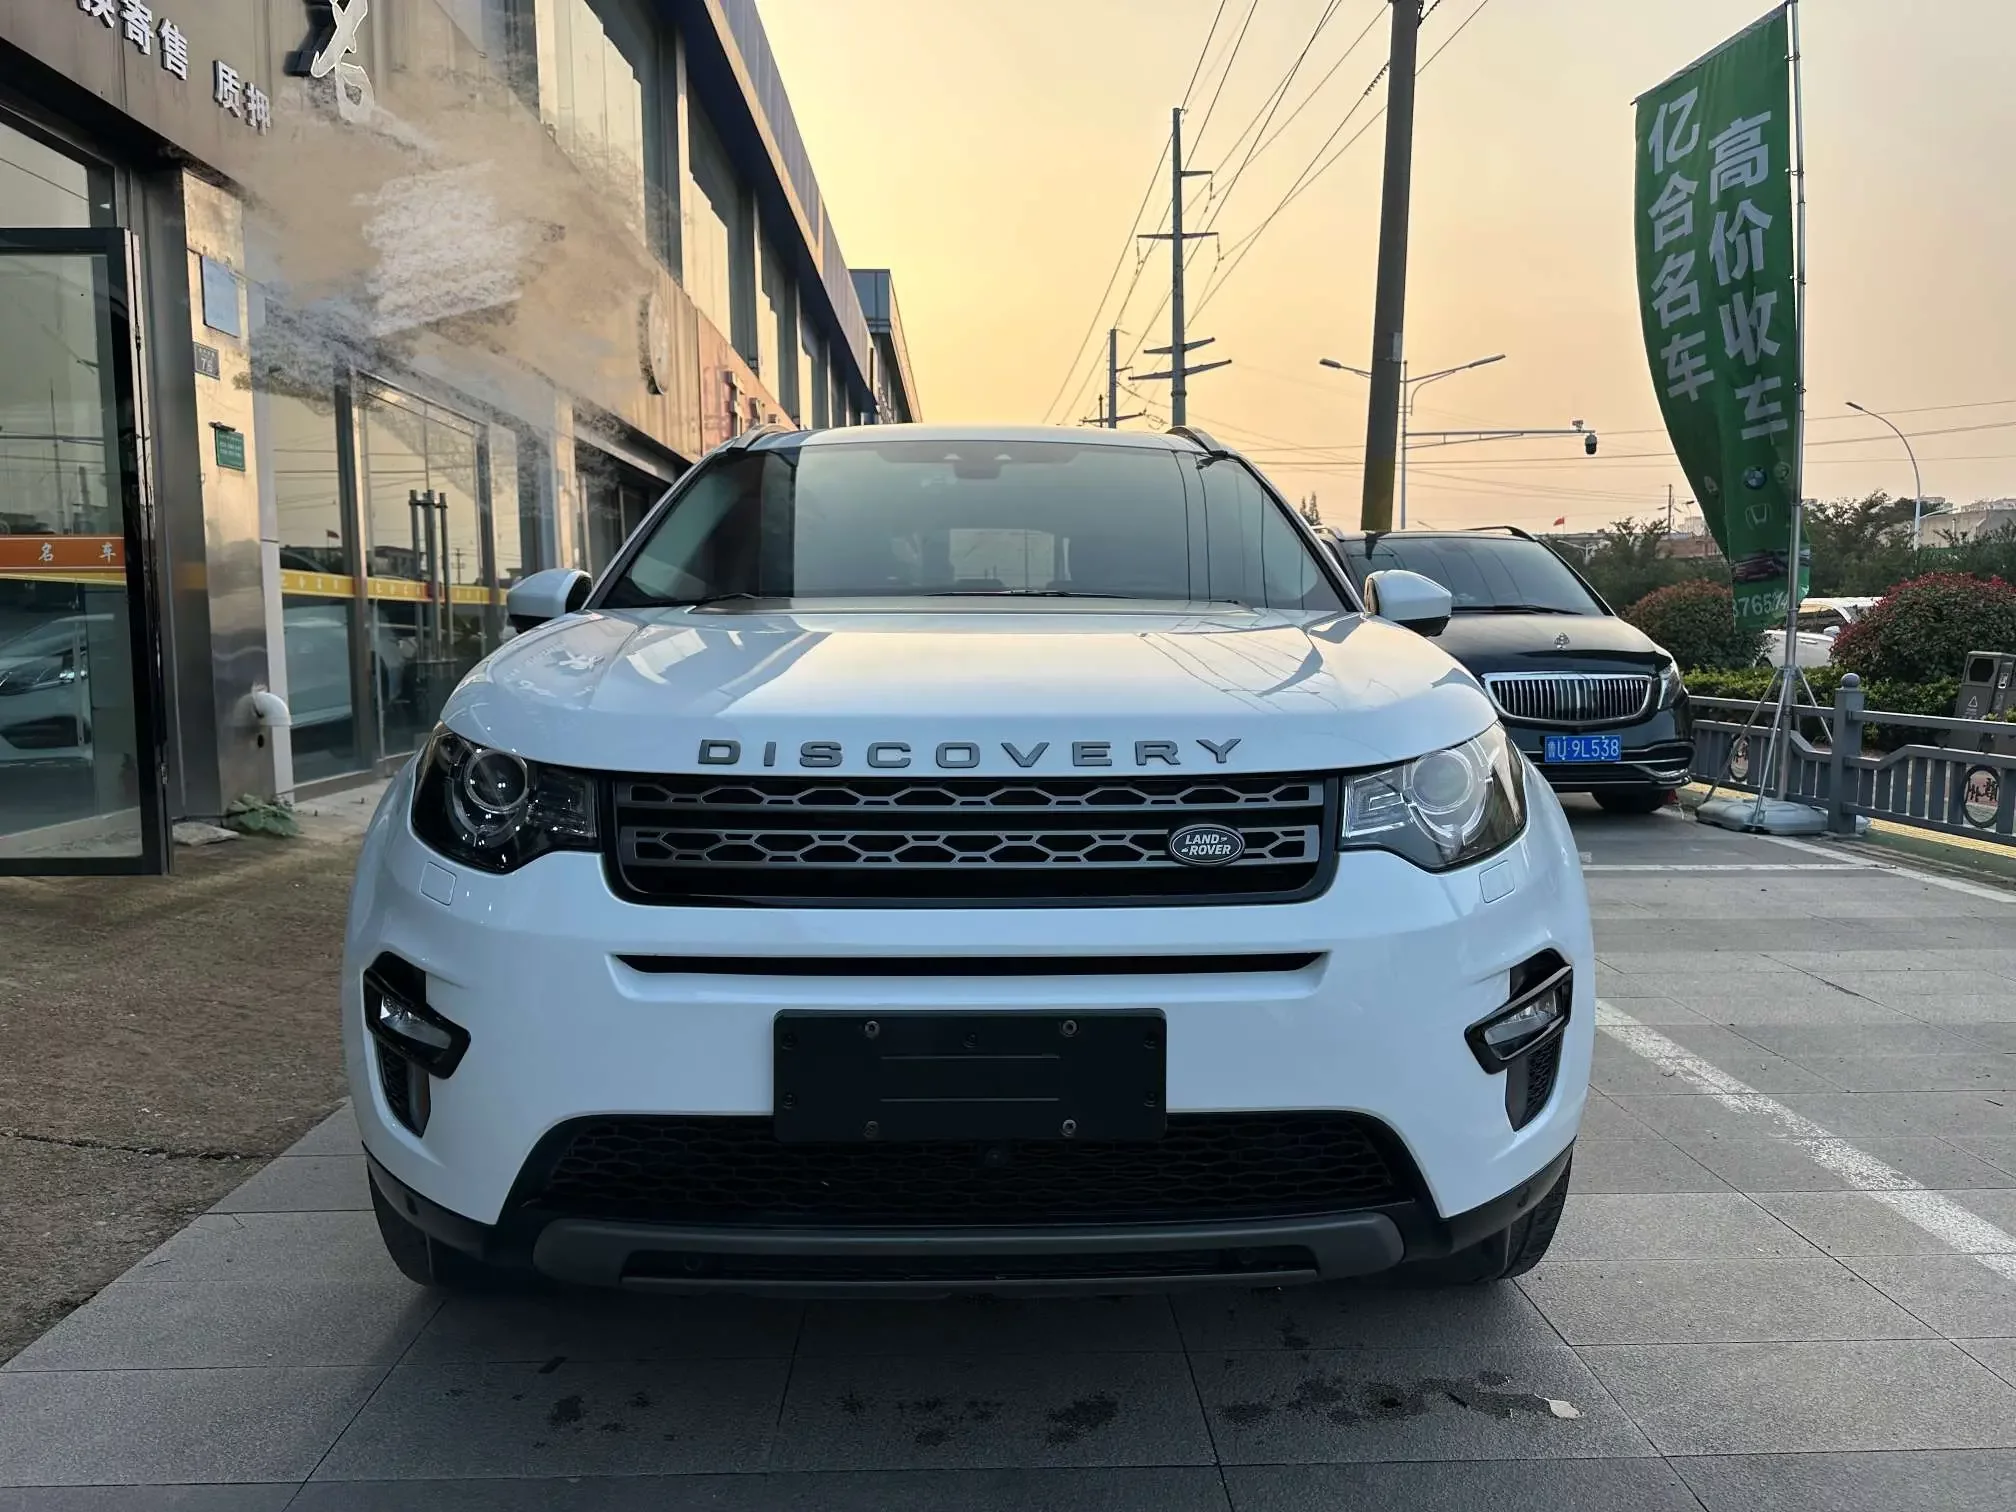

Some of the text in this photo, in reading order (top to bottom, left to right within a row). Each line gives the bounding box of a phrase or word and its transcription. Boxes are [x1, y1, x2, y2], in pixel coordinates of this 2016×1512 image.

[212, 60, 272, 136] 质押
[1648, 87, 1714, 402] 亿合名车
[1707, 110, 1788, 445] 高价收车
[698, 738, 1242, 768] DISCOVERY
[1188, 845, 1232, 856] ROVER
